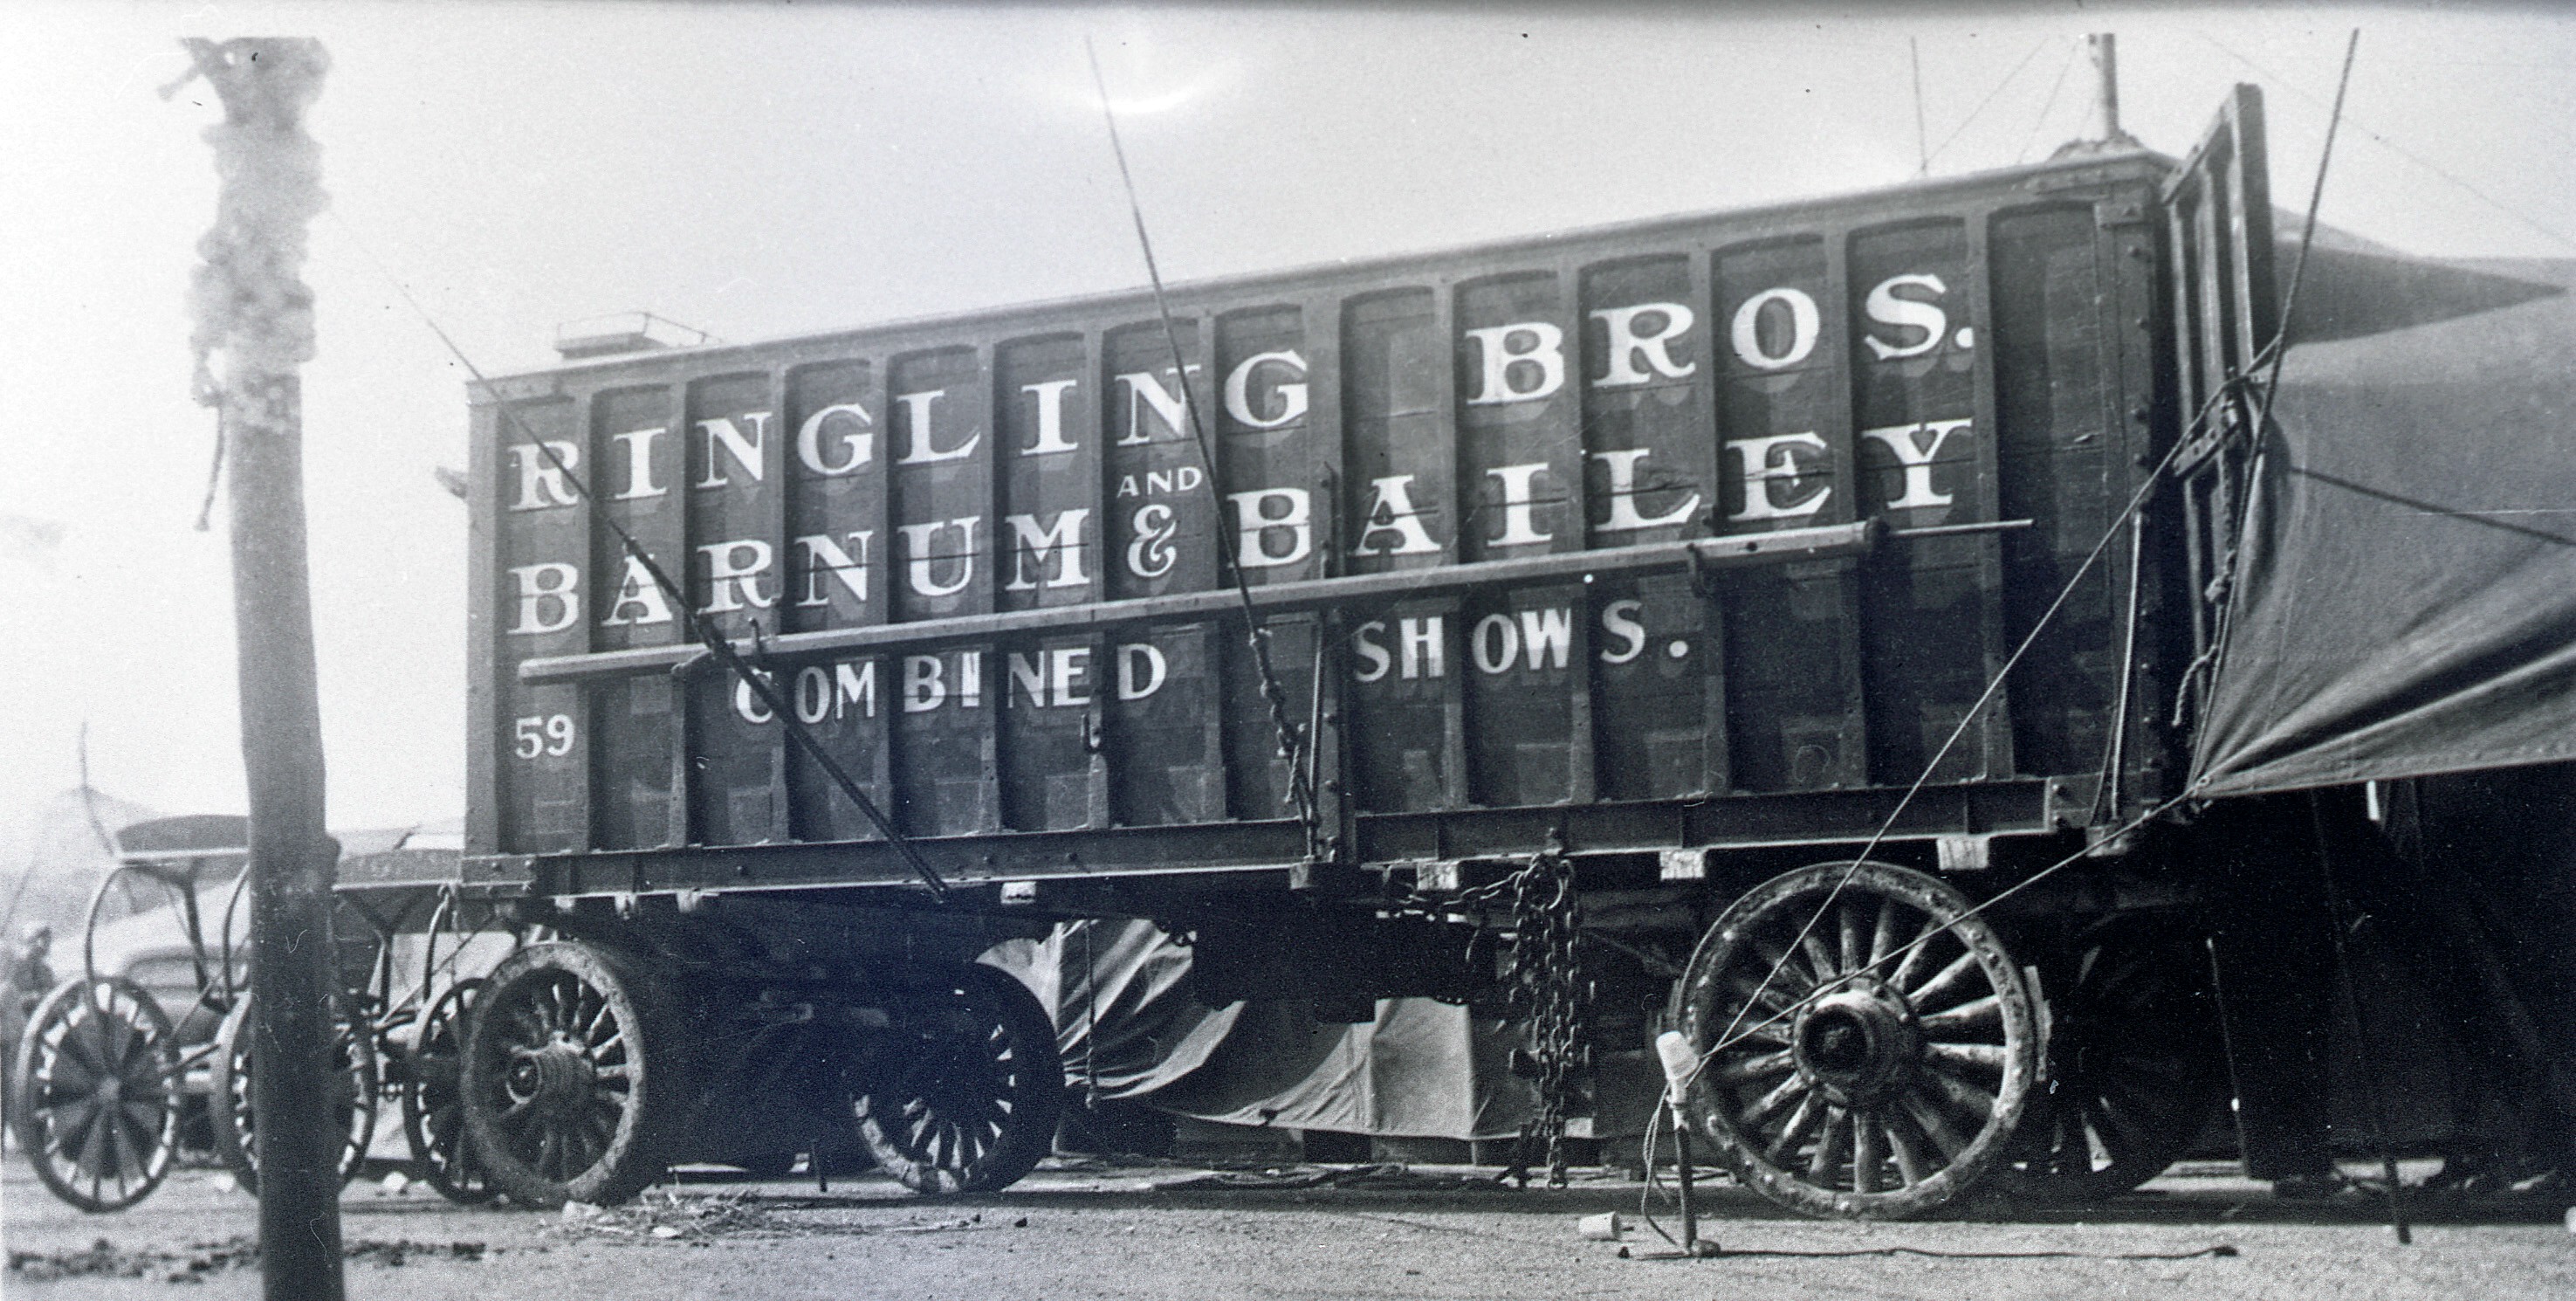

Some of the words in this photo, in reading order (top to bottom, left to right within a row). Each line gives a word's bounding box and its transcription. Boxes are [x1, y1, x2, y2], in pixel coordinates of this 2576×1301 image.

[508, 349, 1309, 511] RINGLING
[1467, 274, 1974, 404] BROS.
[507, 508, 1090, 635] BARNUM
[1127, 504, 1177, 577] &
[1226, 418, 1973, 569] BAILEY
[1116, 466, 1202, 499] AND
[736, 644, 1166, 724] COMBINED
[1353, 600, 1688, 682] SHOWS.
[516, 713, 574, 759] 59
